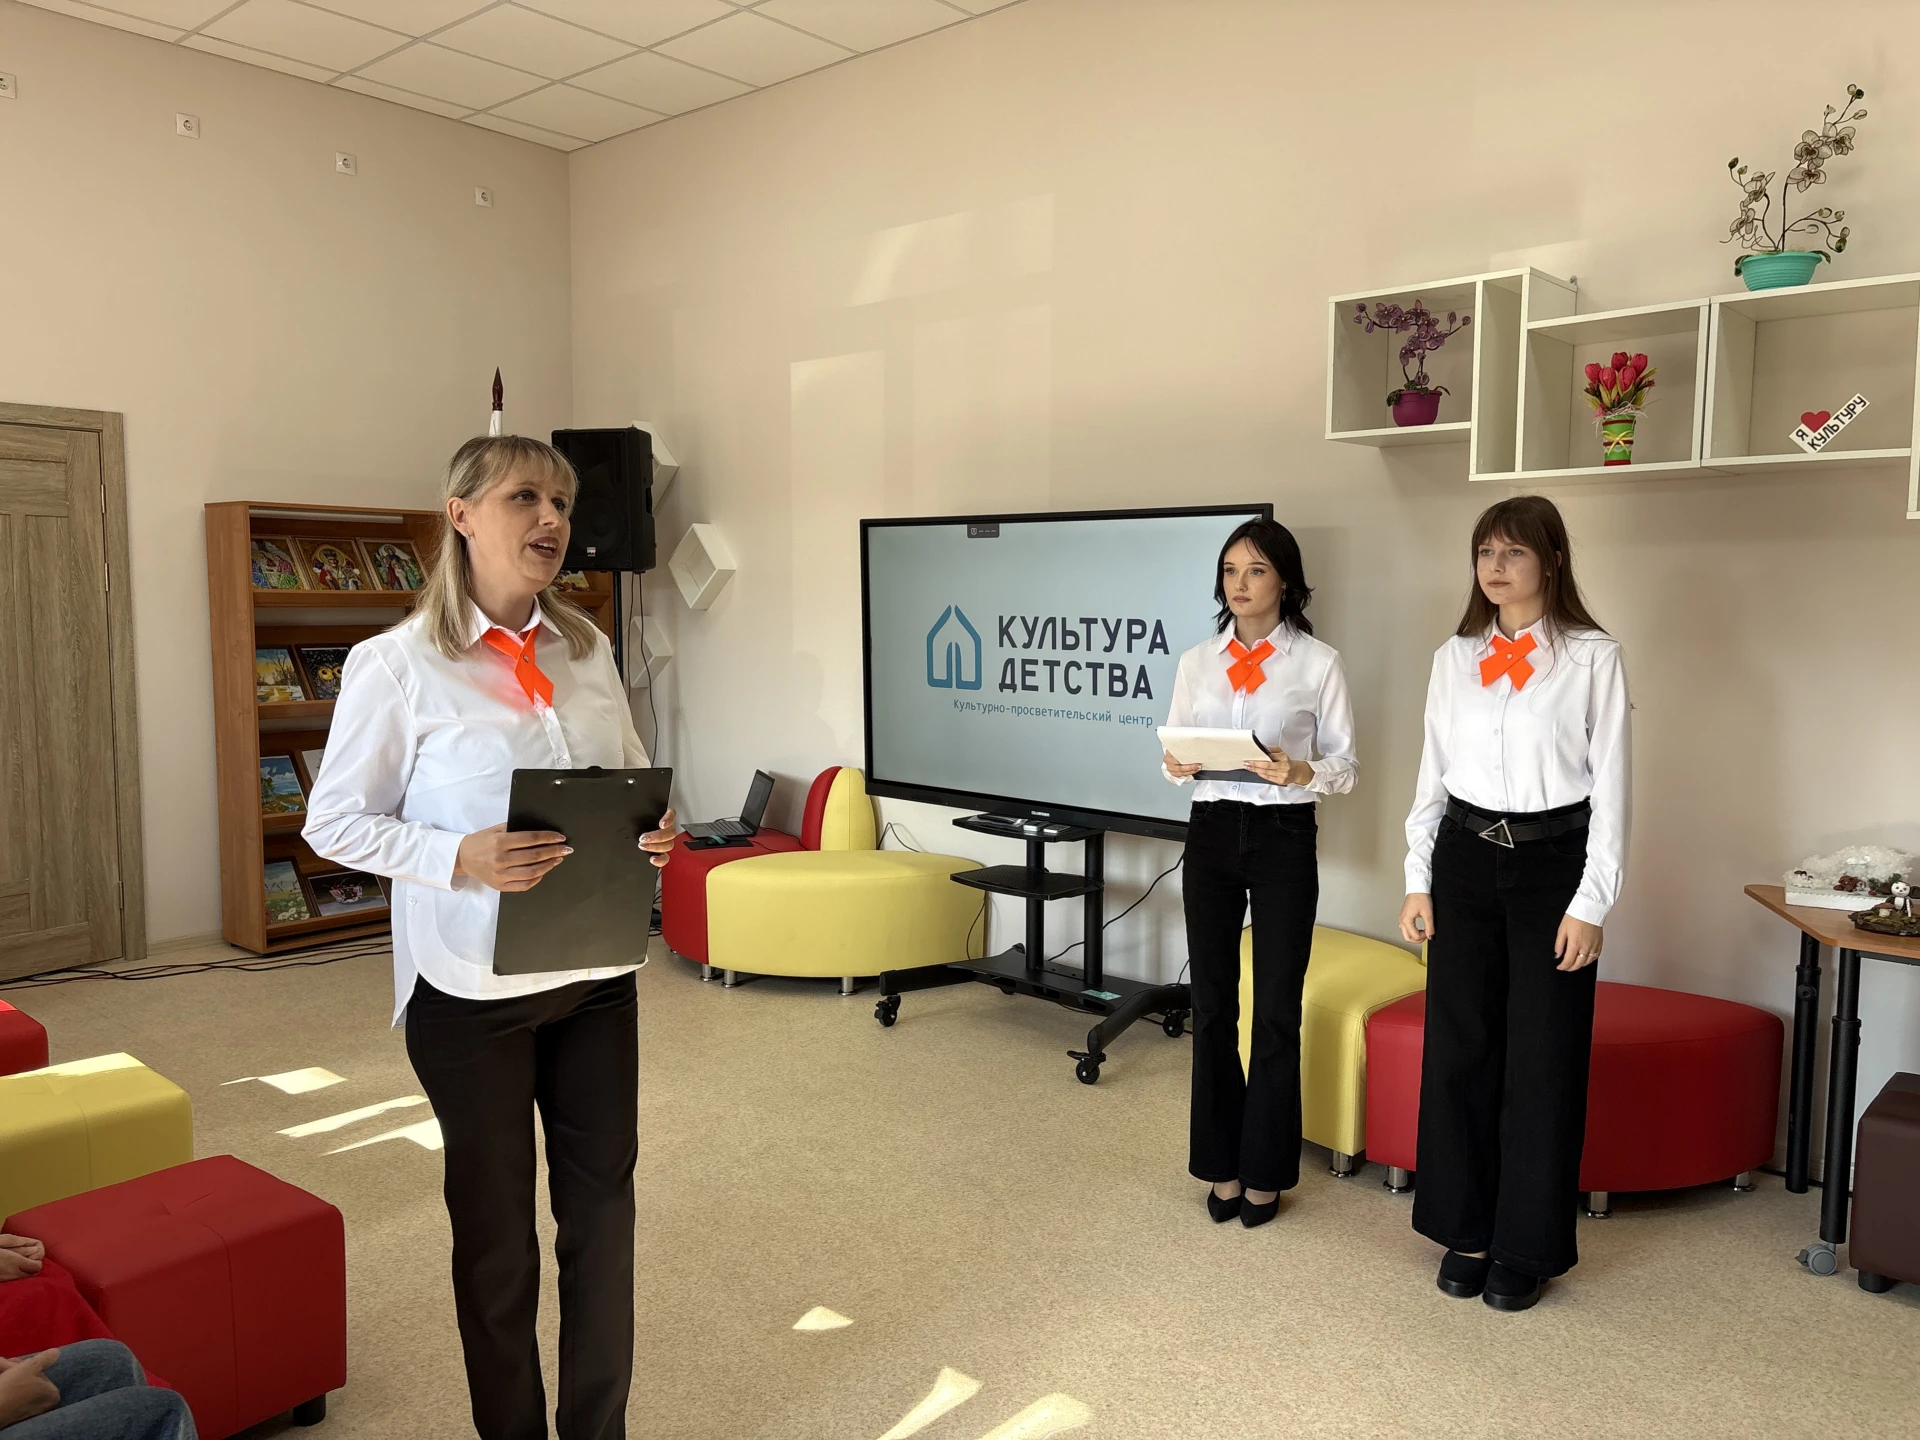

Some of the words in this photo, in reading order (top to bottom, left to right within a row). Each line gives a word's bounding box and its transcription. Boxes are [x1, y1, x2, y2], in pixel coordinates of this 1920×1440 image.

[1796, 429, 1809, 442] Я
[1807, 396, 1867, 451] КУЛЬТУРУ
[999, 615, 1170, 655] КУЛЬТУРА
[998, 658, 1154, 700] ДЕТСТВА
[953, 699, 1112, 723] Культурно-просветительский
[1118, 714, 1153, 728] центр
